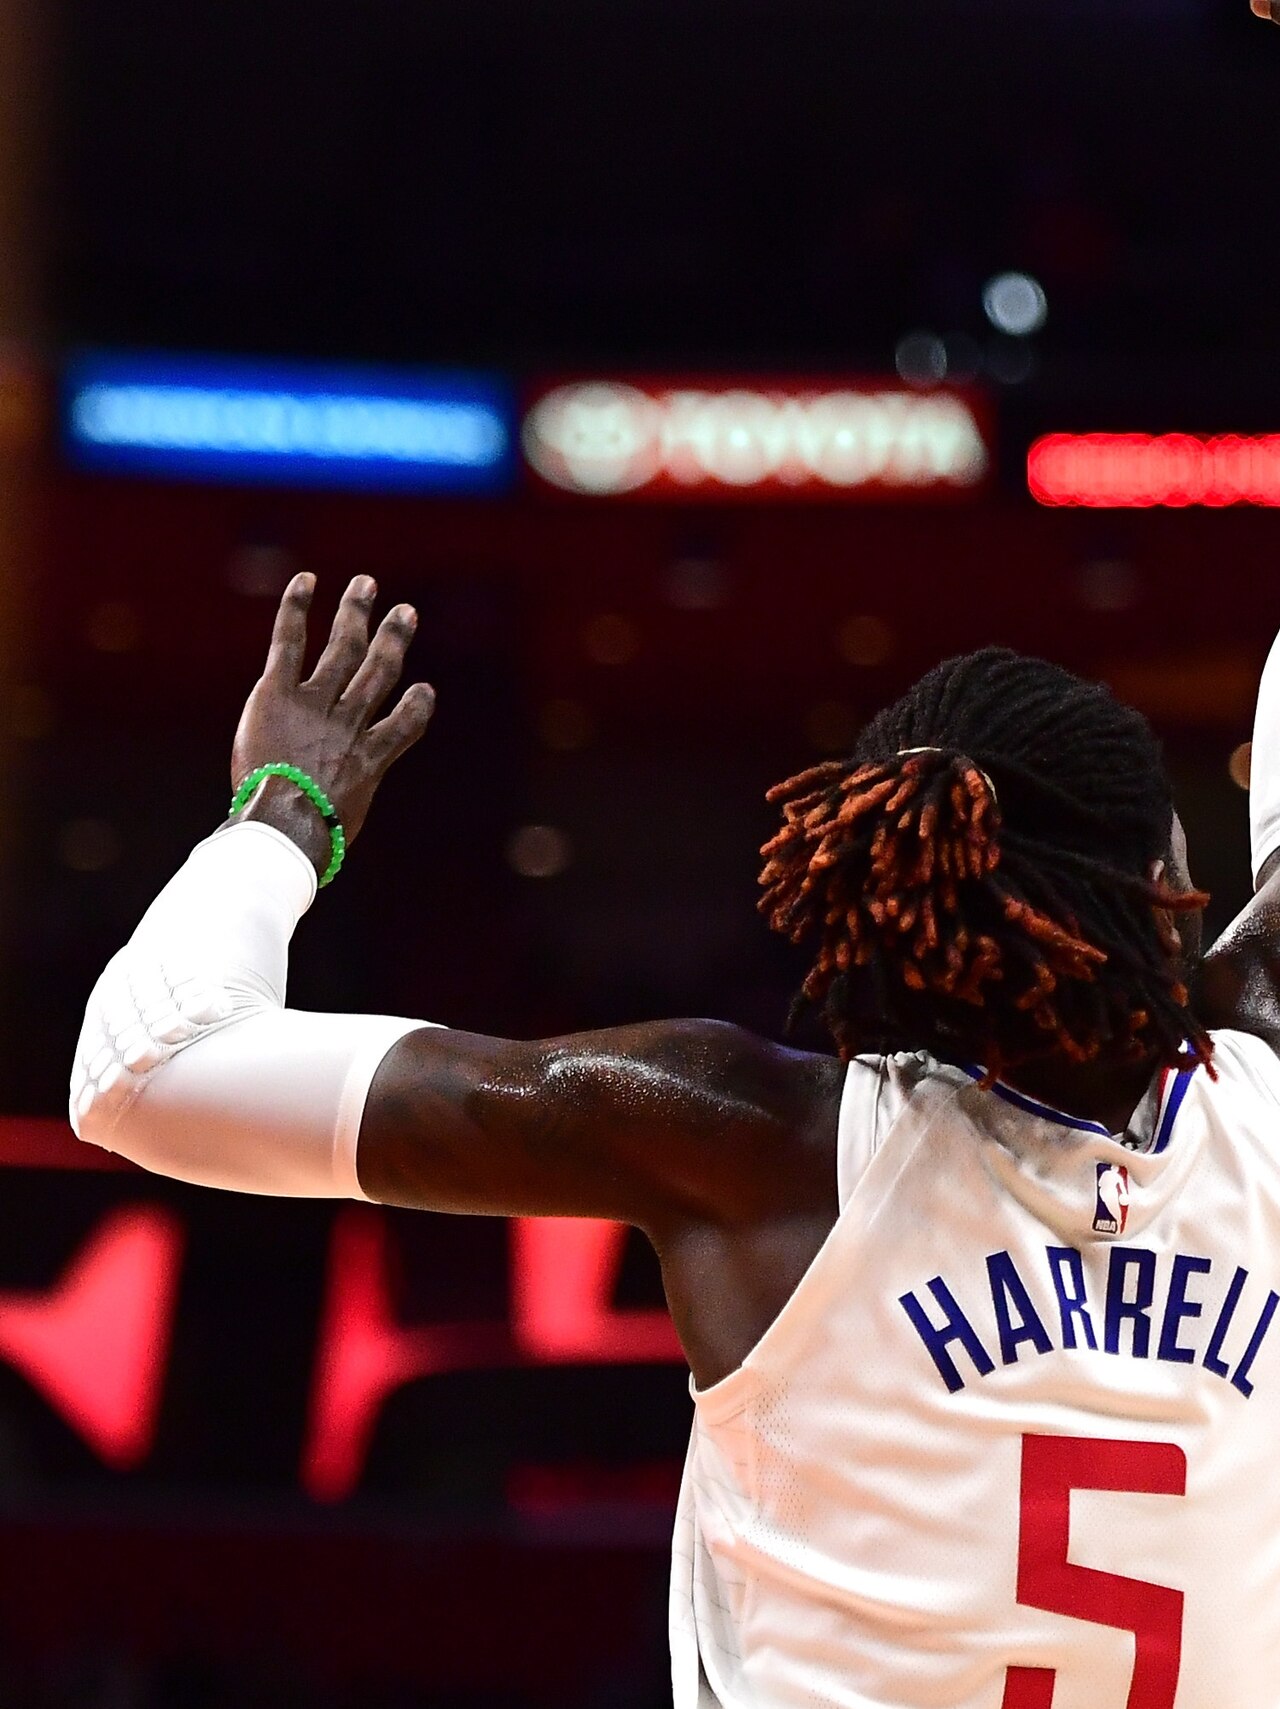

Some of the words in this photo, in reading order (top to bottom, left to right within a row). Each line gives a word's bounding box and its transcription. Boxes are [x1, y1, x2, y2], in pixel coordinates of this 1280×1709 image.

[1095, 1220, 1116, 1232] NBA
[898, 1246, 1280, 1400] HARRELL
[1002, 1433, 1187, 1709] 5
